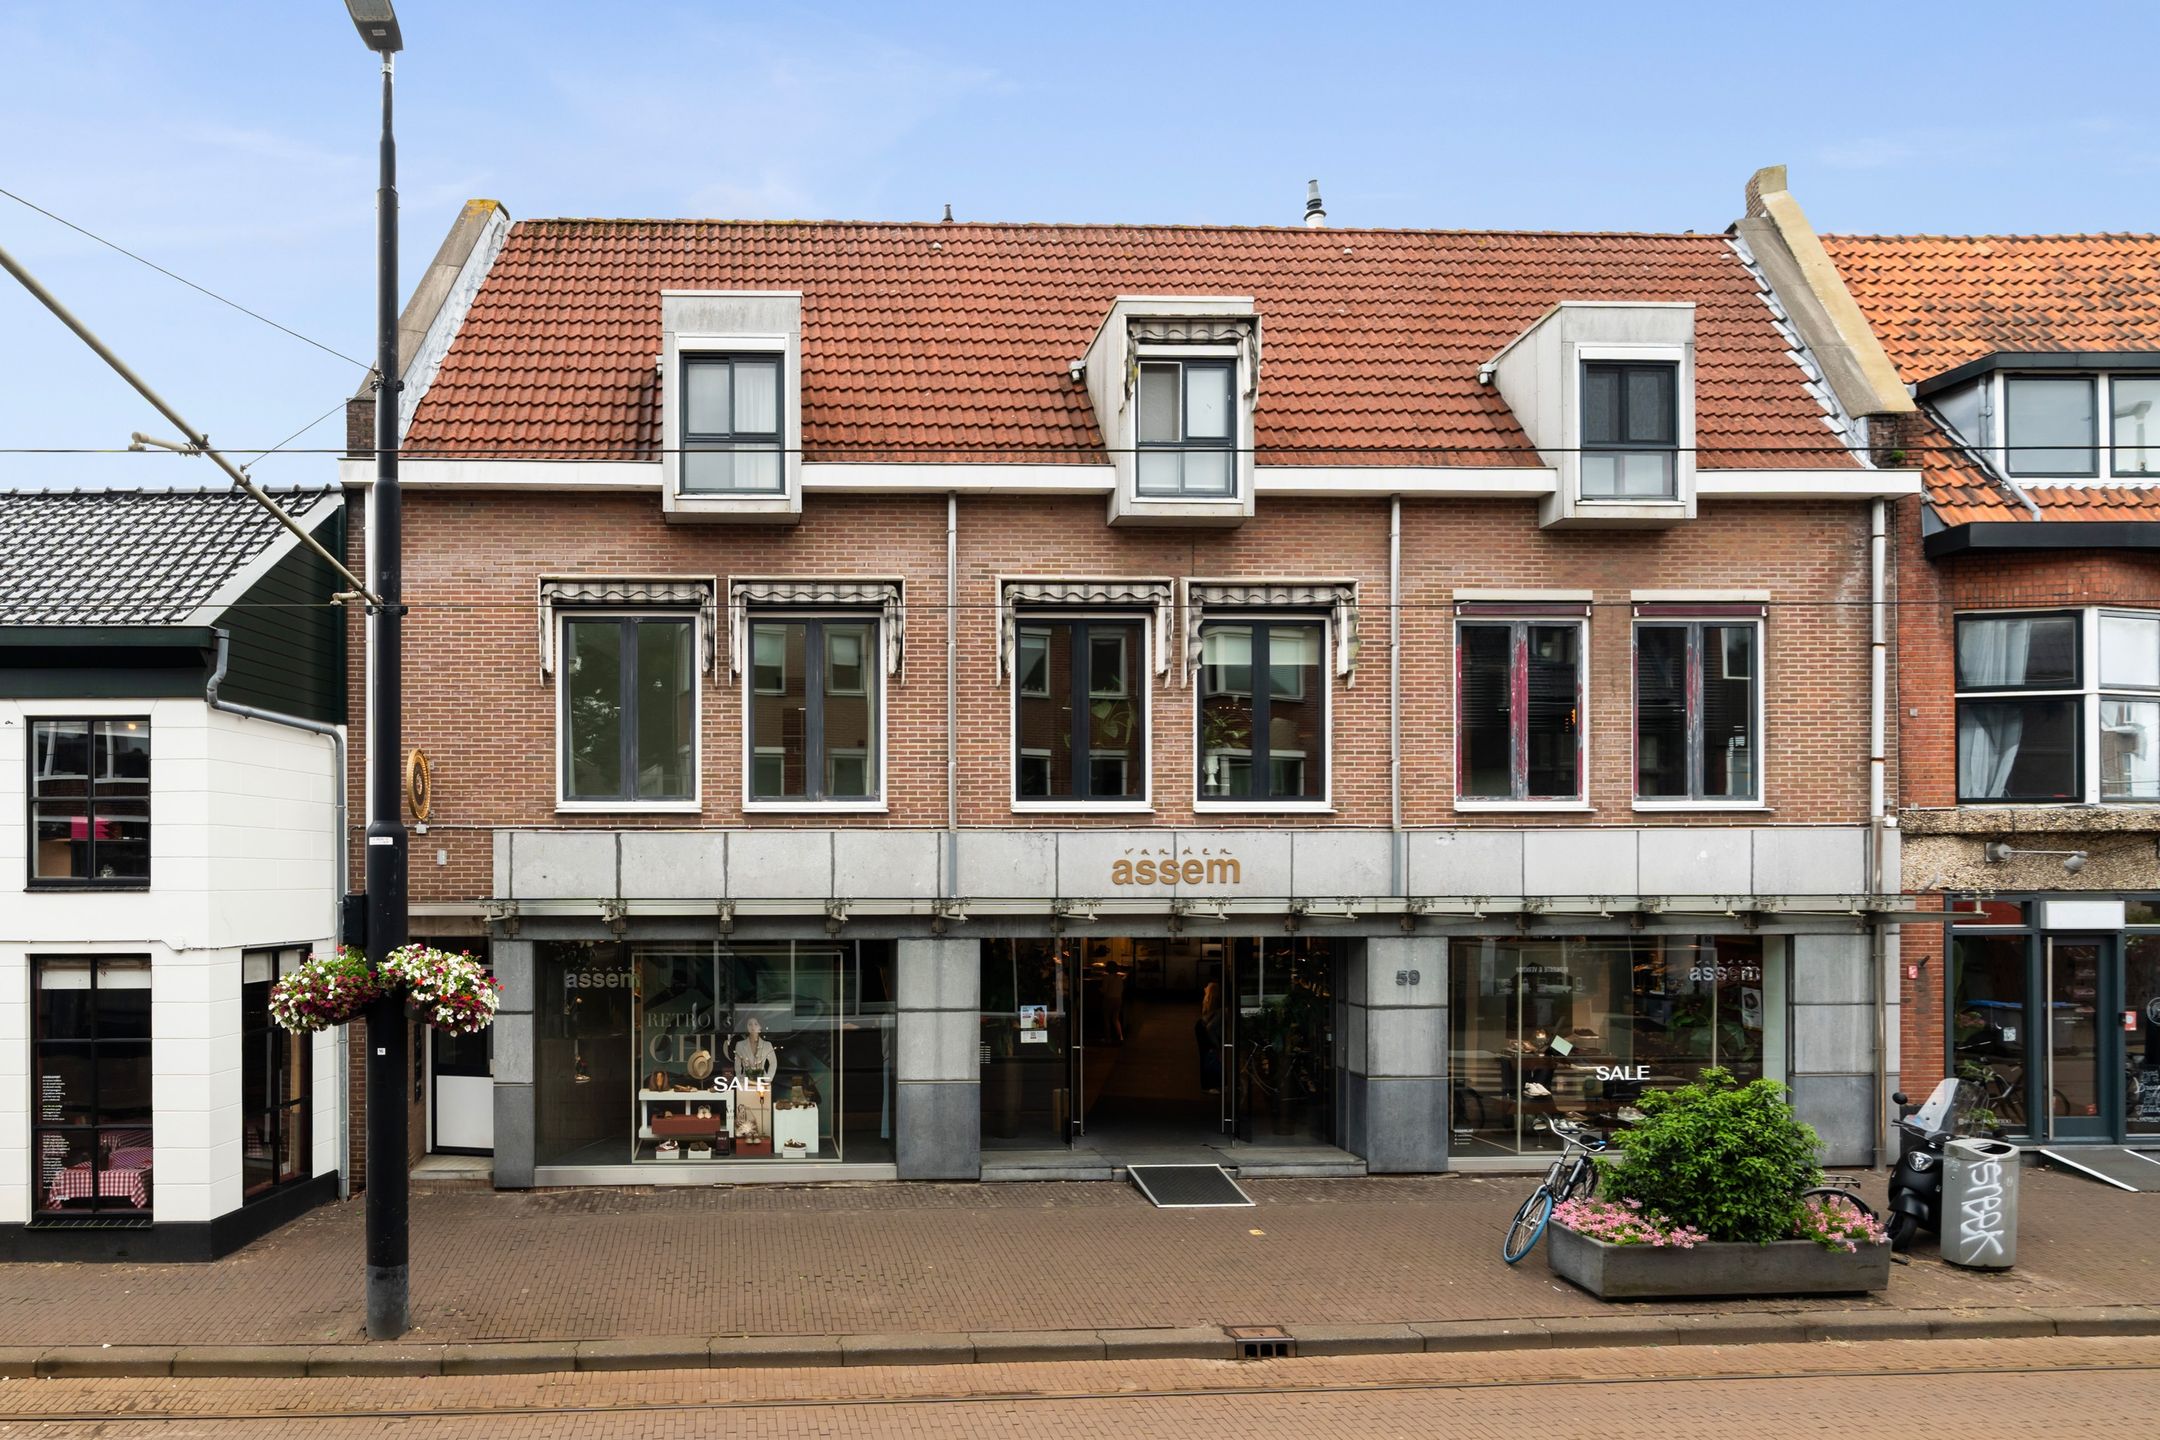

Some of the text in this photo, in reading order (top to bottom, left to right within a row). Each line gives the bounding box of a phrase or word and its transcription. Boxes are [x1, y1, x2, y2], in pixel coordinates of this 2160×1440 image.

[1181, 846, 1232, 855] den
[1112, 859, 1240, 885] assem
[565, 972, 640, 988] assem
[1395, 969, 1420, 986] 59
[1689, 966, 1760, 981] assem
[647, 1013, 711, 1028] RETRO
[1595, 1065, 1651, 1081] SALE
[713, 1076, 771, 1092] SALE
